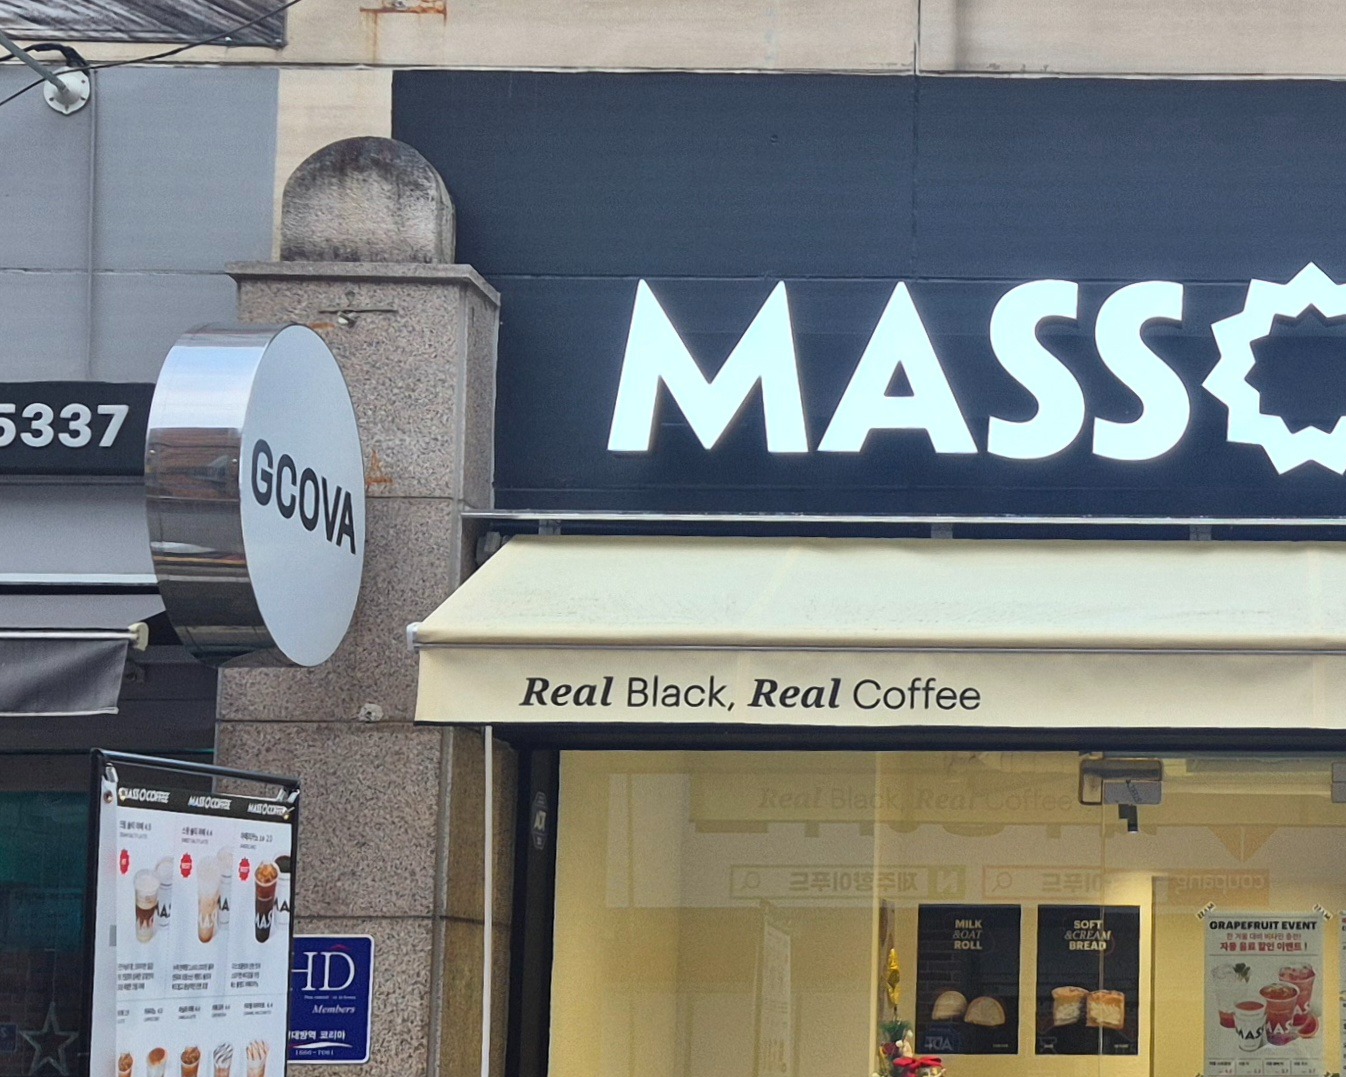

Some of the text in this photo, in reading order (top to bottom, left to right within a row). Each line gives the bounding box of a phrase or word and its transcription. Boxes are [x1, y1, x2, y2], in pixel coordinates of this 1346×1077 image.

[606, 279, 1190, 461] MASS
[251, 438, 356, 555] GCOVA
[519, 676, 981, 712] Real Black, Real Coffee
[955, 919, 983, 929] MILK
[1074, 919, 1103, 930] SOFT
[1209, 921, 1317, 930] GRAPEFRUIT EVENT
[954, 940, 983, 950] ROLL
[1069, 940, 1107, 951] BREAD
[1277, 942, 1302, 951] 이벤트
[312, 1004, 355, 1013] Members
[288, 1030, 346, 1040] 대방역 코리아
